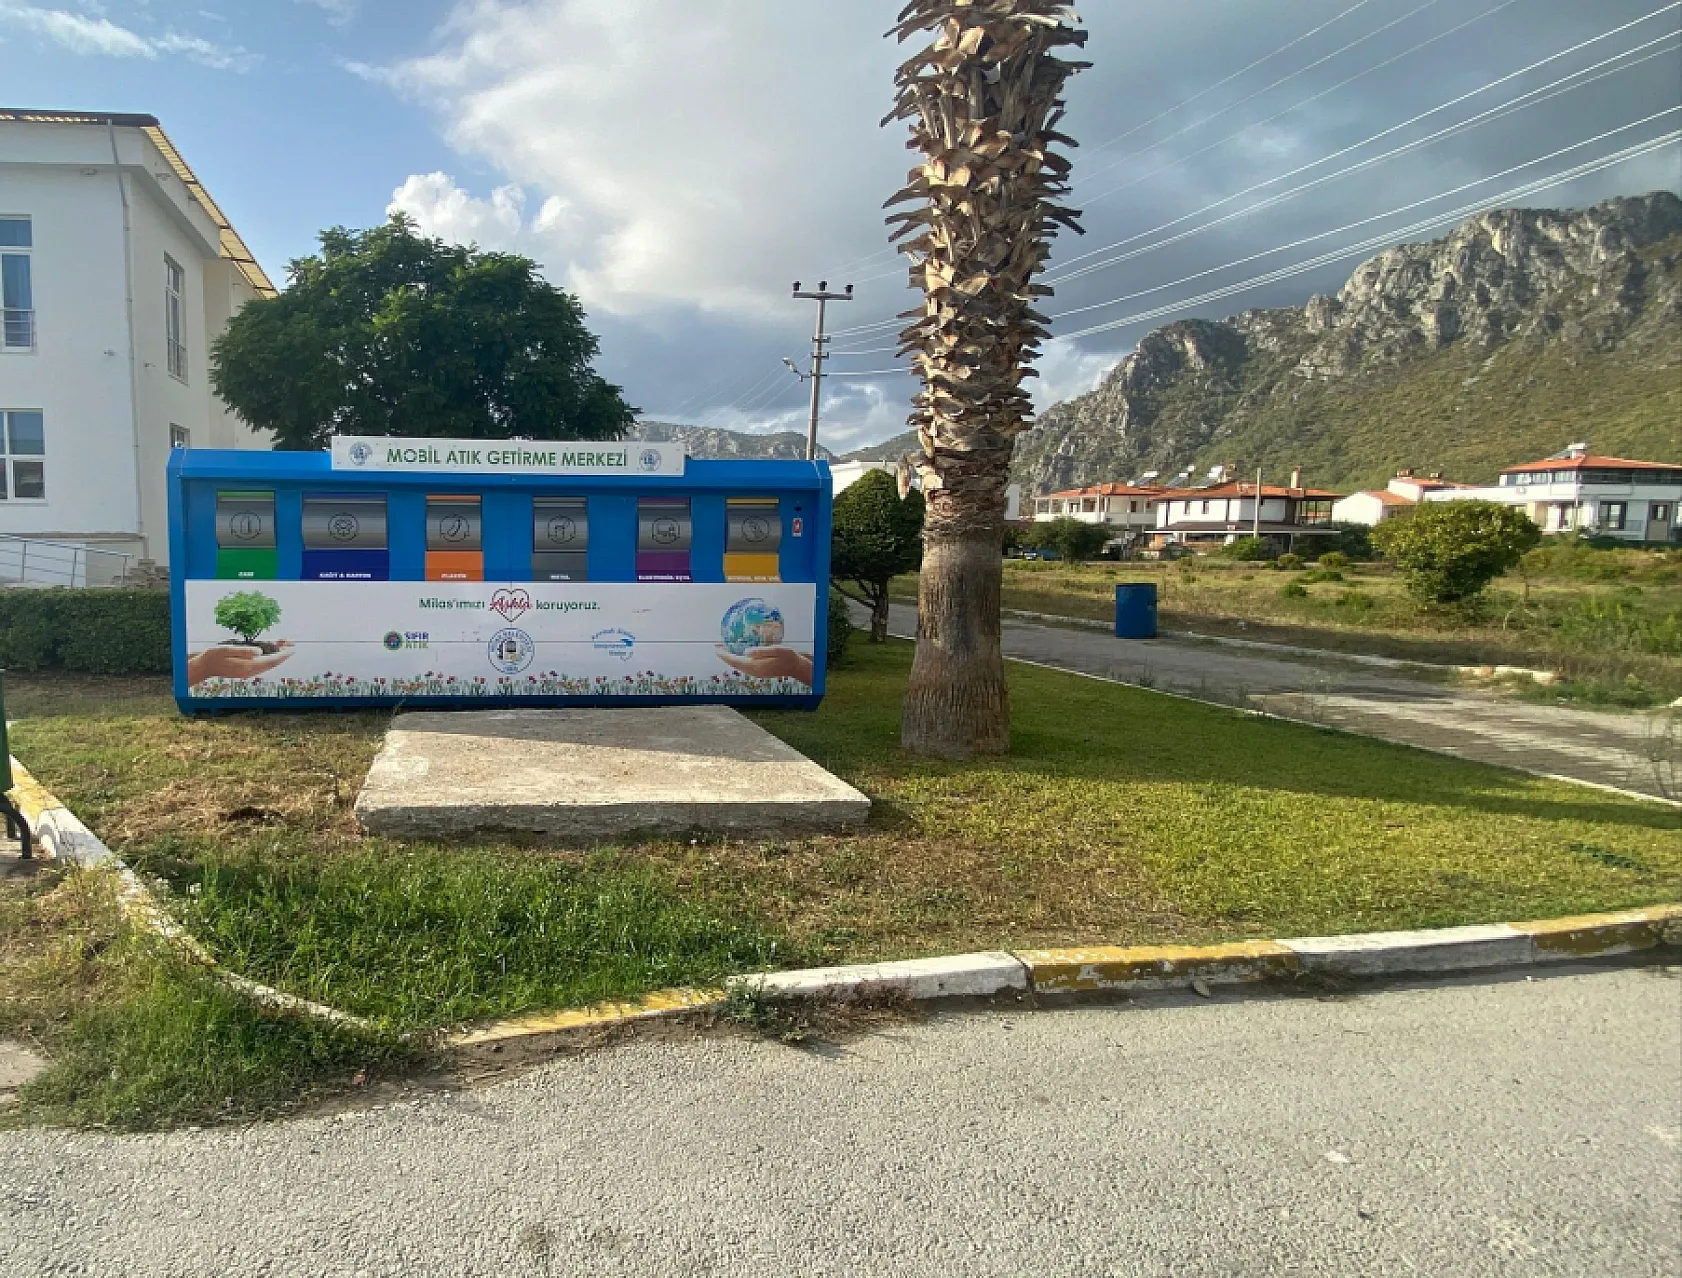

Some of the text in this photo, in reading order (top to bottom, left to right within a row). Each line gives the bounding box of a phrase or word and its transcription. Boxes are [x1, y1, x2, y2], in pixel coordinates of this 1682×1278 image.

[386, 445, 441, 465] MOBİL
[446, 450, 481, 465] ATIK
[487, 447, 556, 466] GETİRME
[561, 447, 627, 467] MERKEZİ
[535, 599, 601, 613] koruyoruz.
